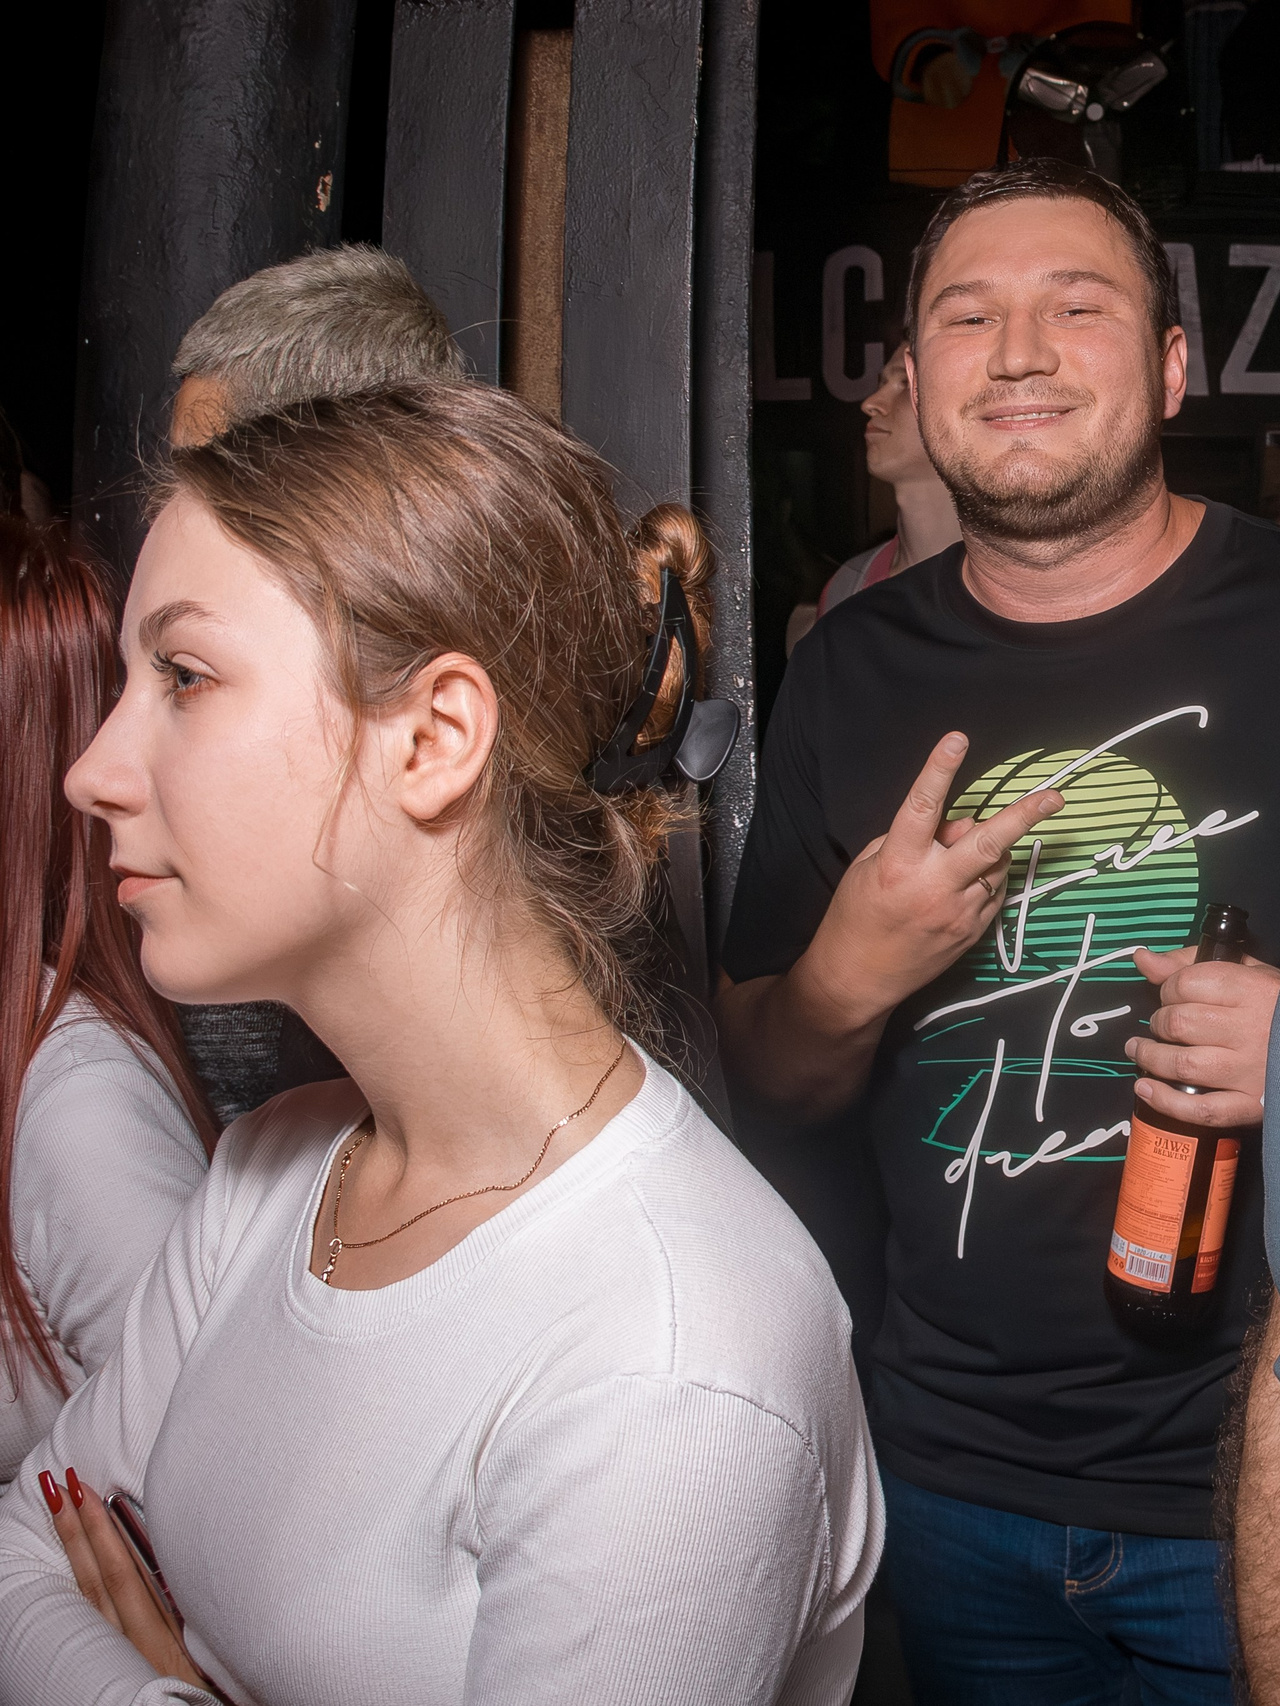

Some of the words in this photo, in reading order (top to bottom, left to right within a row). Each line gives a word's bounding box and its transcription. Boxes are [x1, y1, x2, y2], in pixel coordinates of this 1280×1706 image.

[914, 913, 1148, 1122] To
[944, 1038, 1131, 1259] drea
[1154, 1136, 1190, 1154] JAWS
